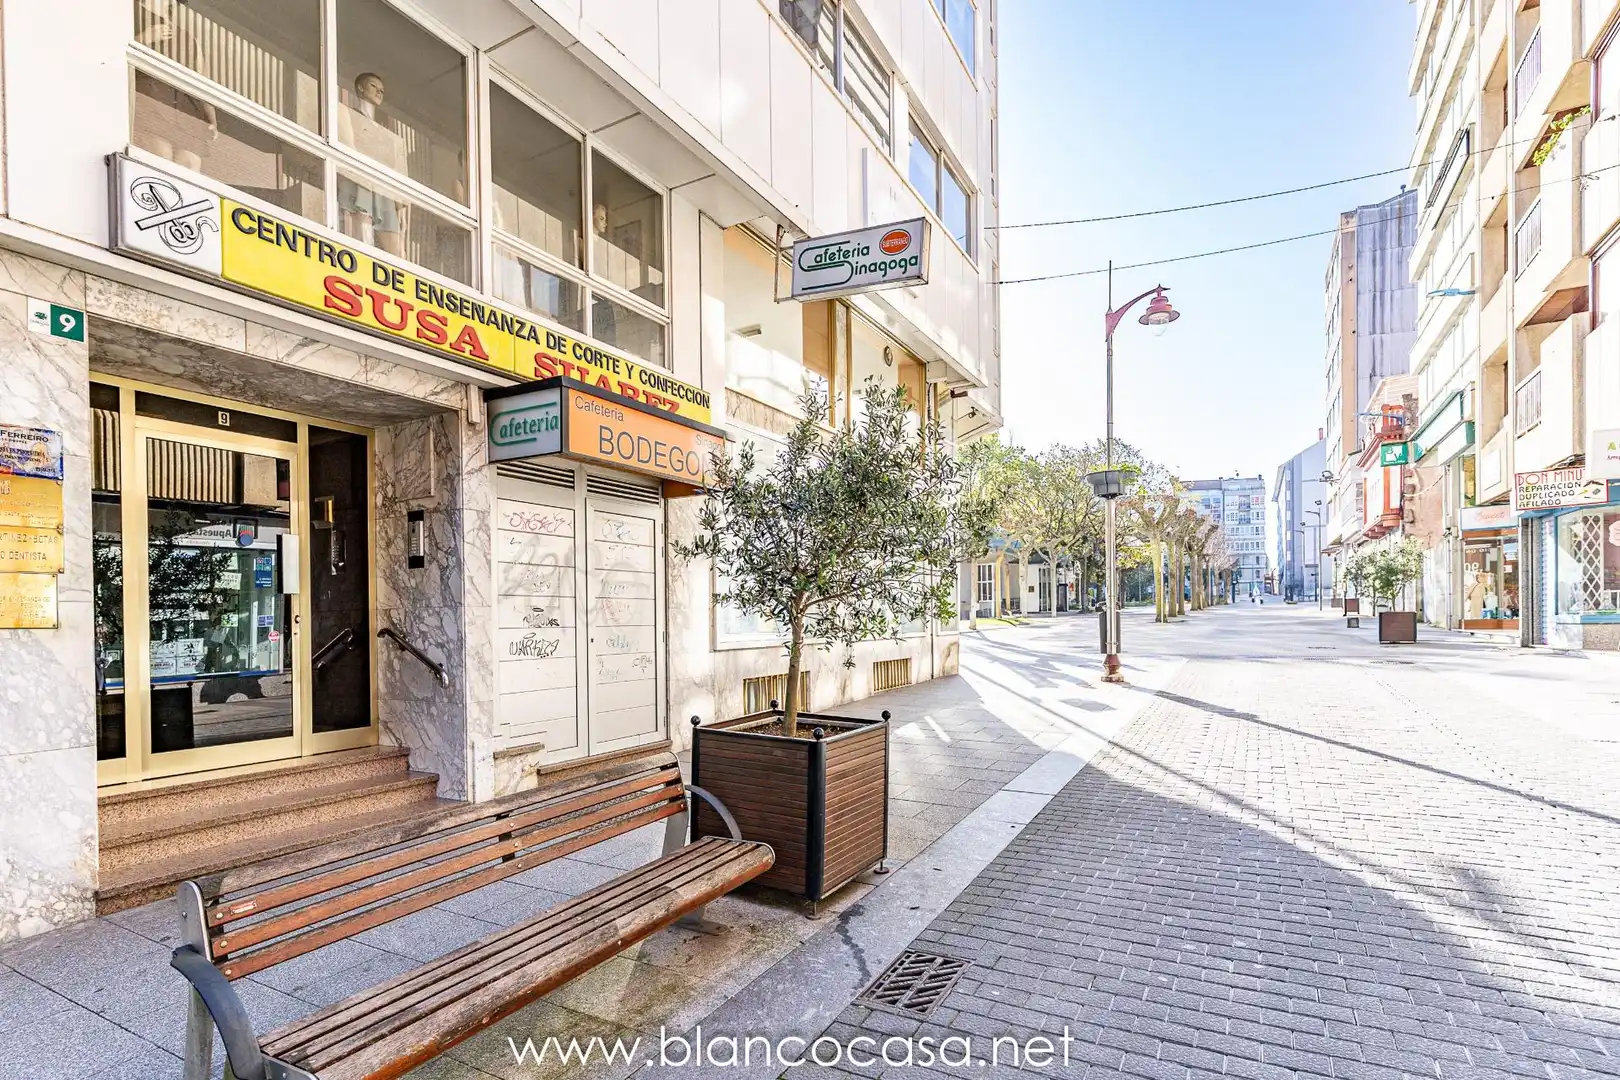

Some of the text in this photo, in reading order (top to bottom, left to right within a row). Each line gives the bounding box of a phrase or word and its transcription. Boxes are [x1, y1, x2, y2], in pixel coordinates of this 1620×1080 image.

[798, 240, 870, 272] Cafeteria
[801, 253, 919, 291] Sinagoga
[231, 207, 357, 273] CENTRO
[372, 262, 405, 293] DE
[546, 331, 567, 355] DE
[572, 342, 620, 375] CORTE
[625, 363, 635, 380] Y
[639, 369, 711, 409] CONFECCION
[59, 313, 76, 333] 9
[323, 275, 489, 361] SUSA
[220, 412, 229, 424] 9
[574, 395, 625, 422] Cafeteria
[489, 402, 560, 447] Cafeteria
[0, 429, 49, 443] FERREIRO
[1518, 468, 1586, 487] DON MINU
[1518, 481, 1582, 493] REPARACION
[1518, 490, 1576, 501] DUPLICADO
[1518, 498, 1562, 509] AFILADO
[9, 551, 47, 561] DENTISTA
